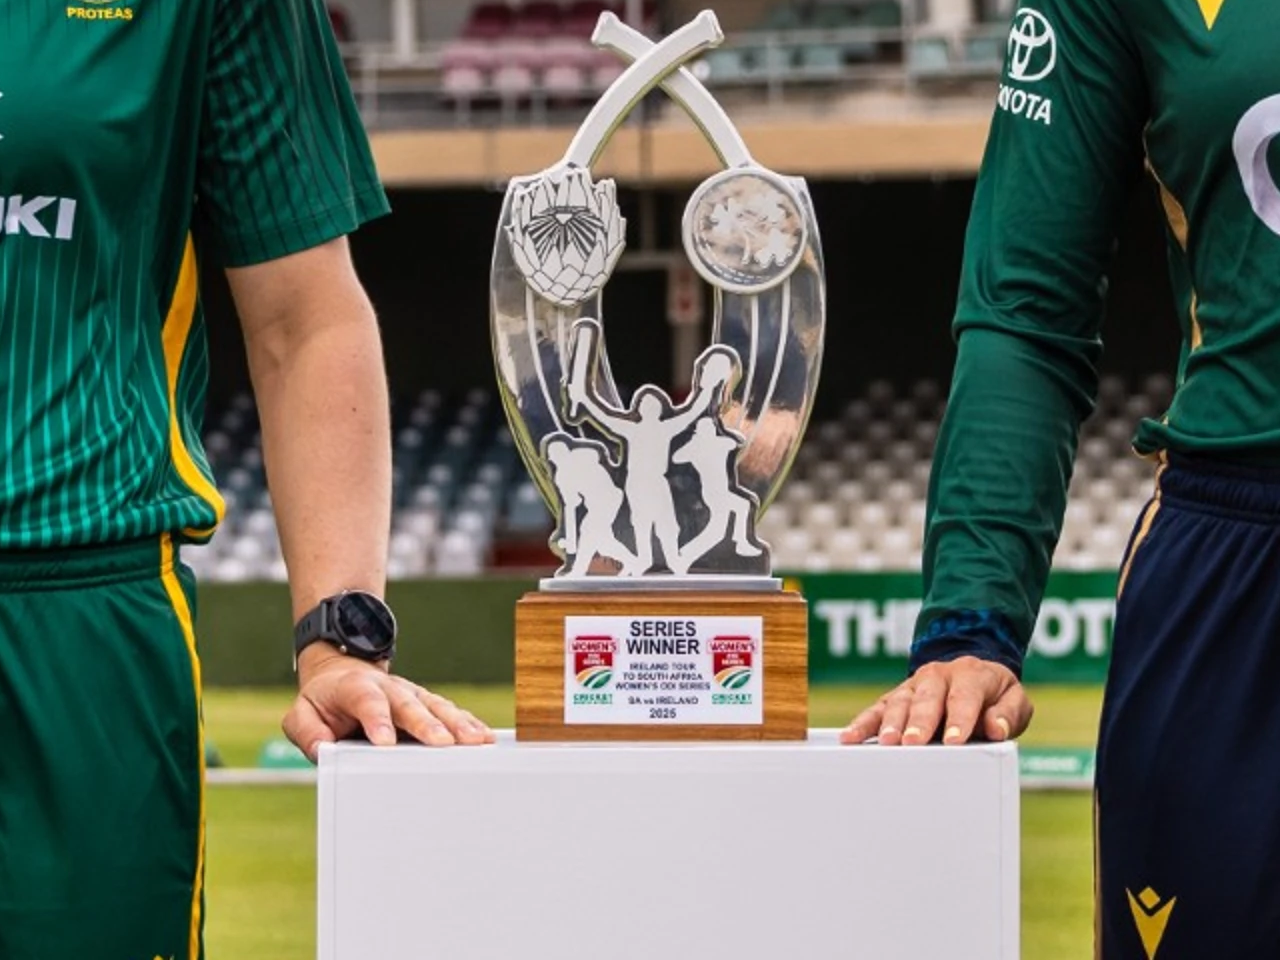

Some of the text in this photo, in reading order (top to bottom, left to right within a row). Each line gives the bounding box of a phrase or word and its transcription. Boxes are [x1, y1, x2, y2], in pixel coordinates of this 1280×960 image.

[66, 7, 133, 20] PROTEAS
[630, 621, 697, 637] SERIES
[626, 639, 700, 655] WINNER
[630, 663, 697, 671] IRELAND TOUR
[623, 672, 703, 681] TO SOUTH AFRICA
[615, 682, 659, 690] WOMEN'S
[679, 682, 711, 690] SERIES
[628, 696, 642, 705] SA
[656, 696, 699, 705] IRELAND
